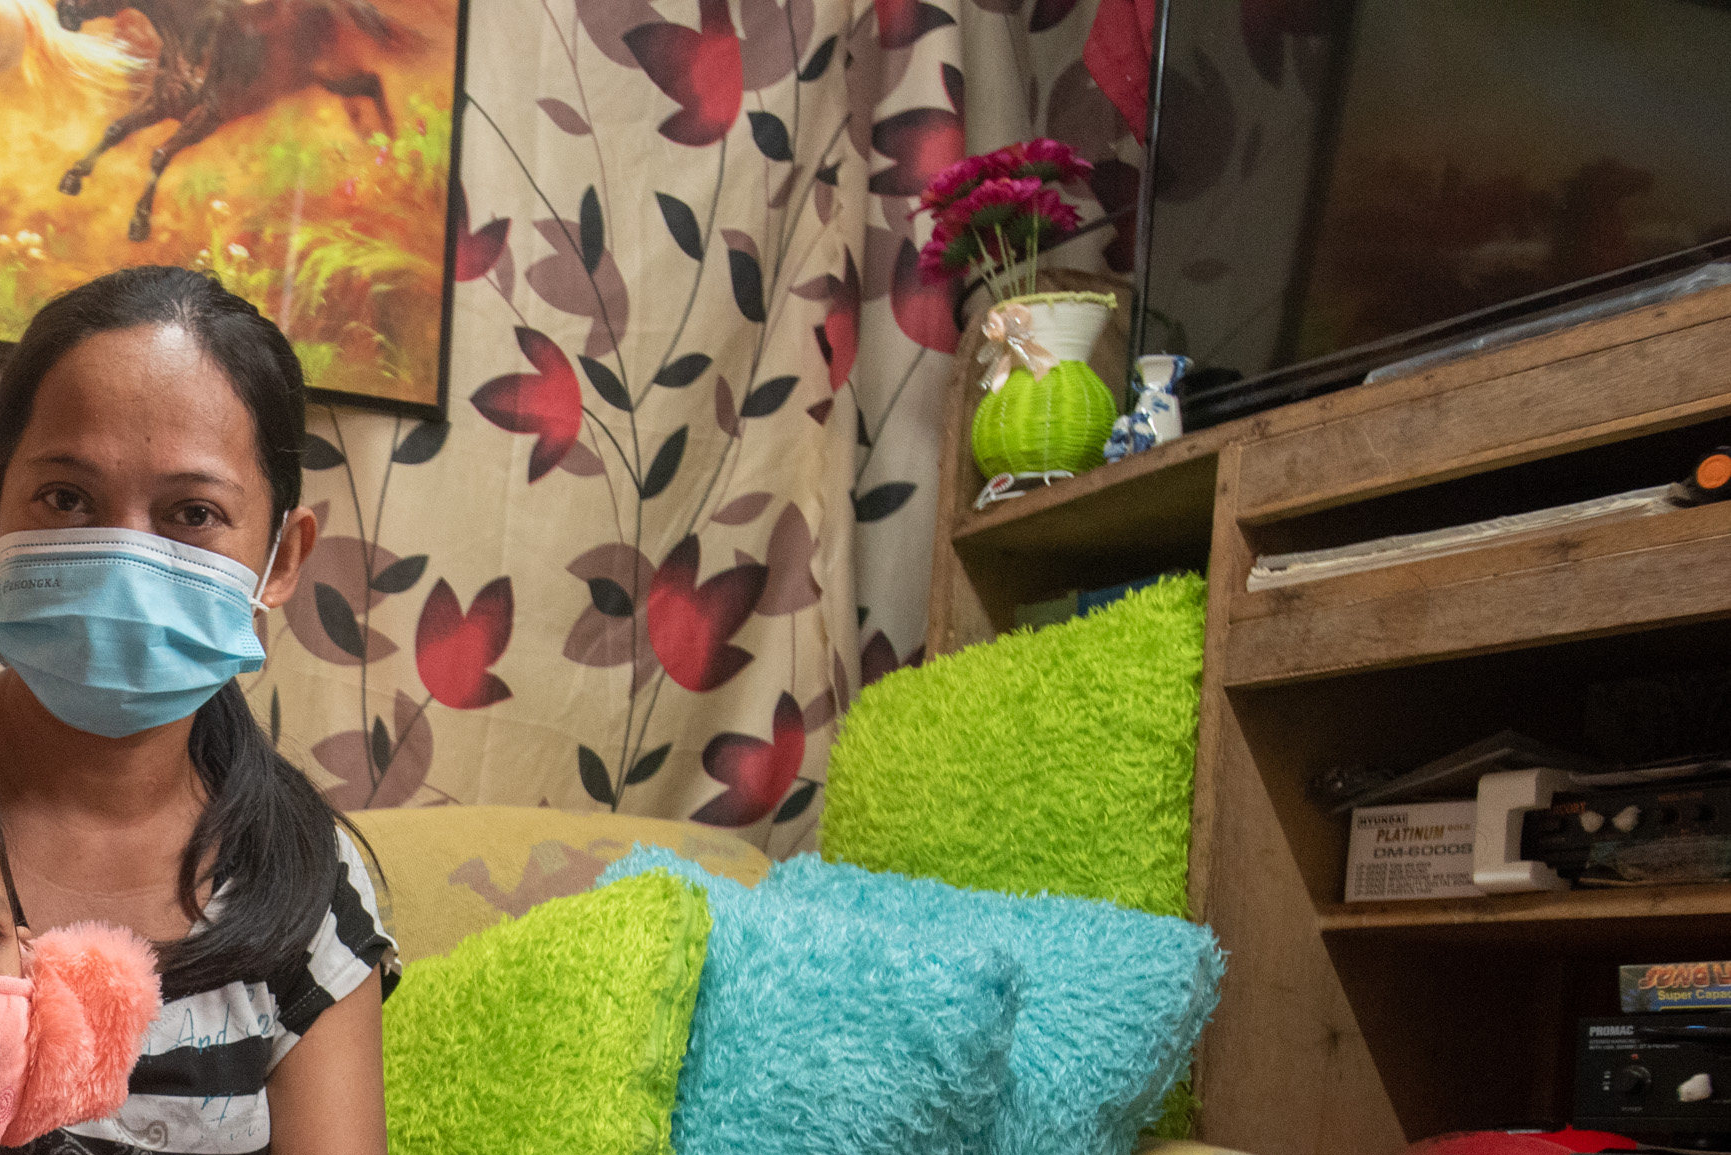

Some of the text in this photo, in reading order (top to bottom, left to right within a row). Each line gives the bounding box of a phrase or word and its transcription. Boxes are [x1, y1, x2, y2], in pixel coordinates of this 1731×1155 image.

[1358, 814, 1407, 827] HYUNDAI
[1376, 824, 1445, 843] PLATINUM
[1657, 989, 1692, 1002] Super
[1589, 1025, 1634, 1037] PROMAC
